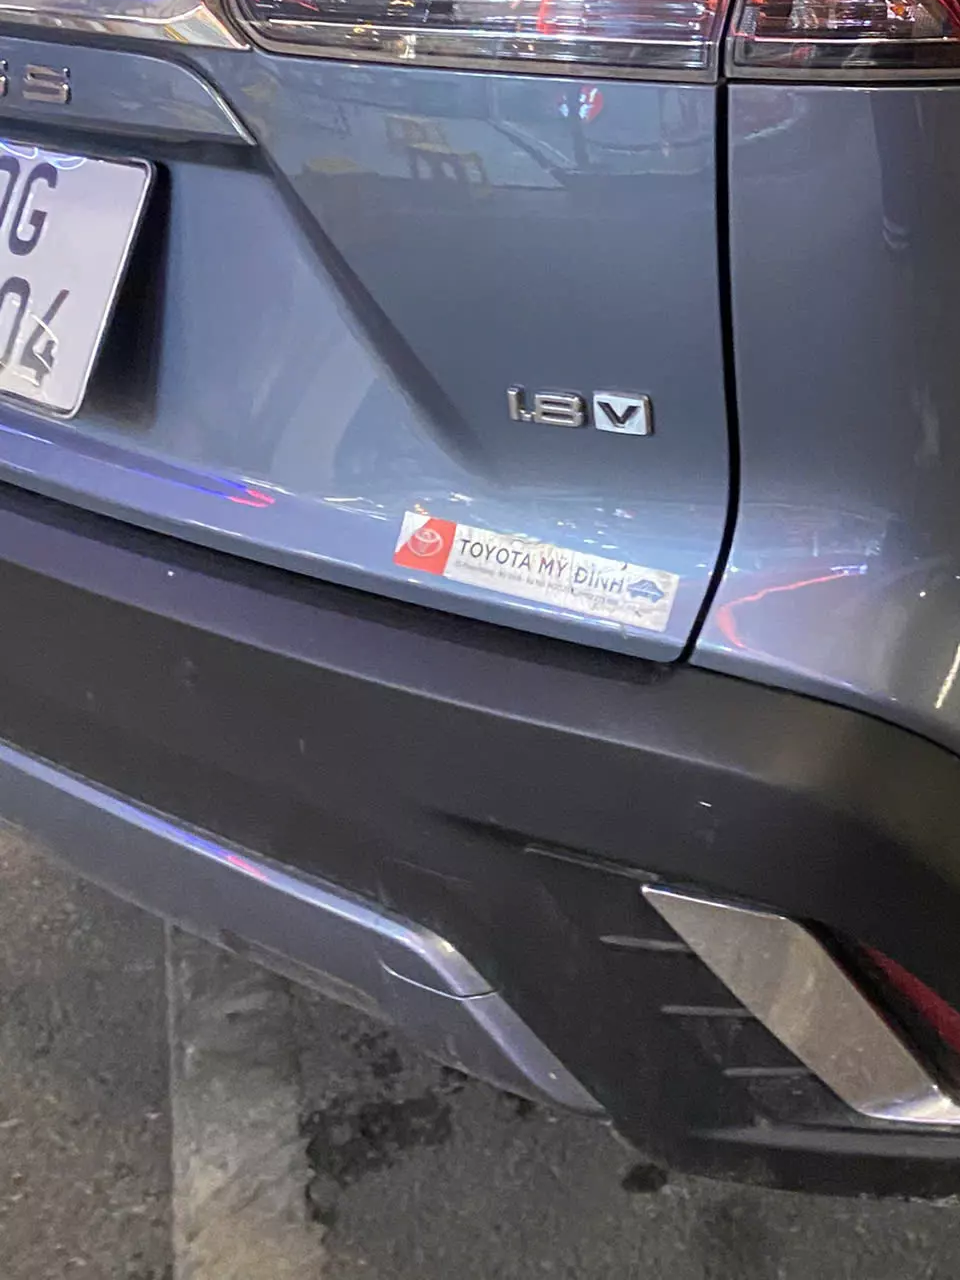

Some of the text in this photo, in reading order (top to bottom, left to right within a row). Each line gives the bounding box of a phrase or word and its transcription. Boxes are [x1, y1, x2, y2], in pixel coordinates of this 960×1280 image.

[507, 384, 644, 430] 1.8 V
[460, 538, 531, 571] TOYOTA
[574, 561, 626, 594] ĐÌNH
